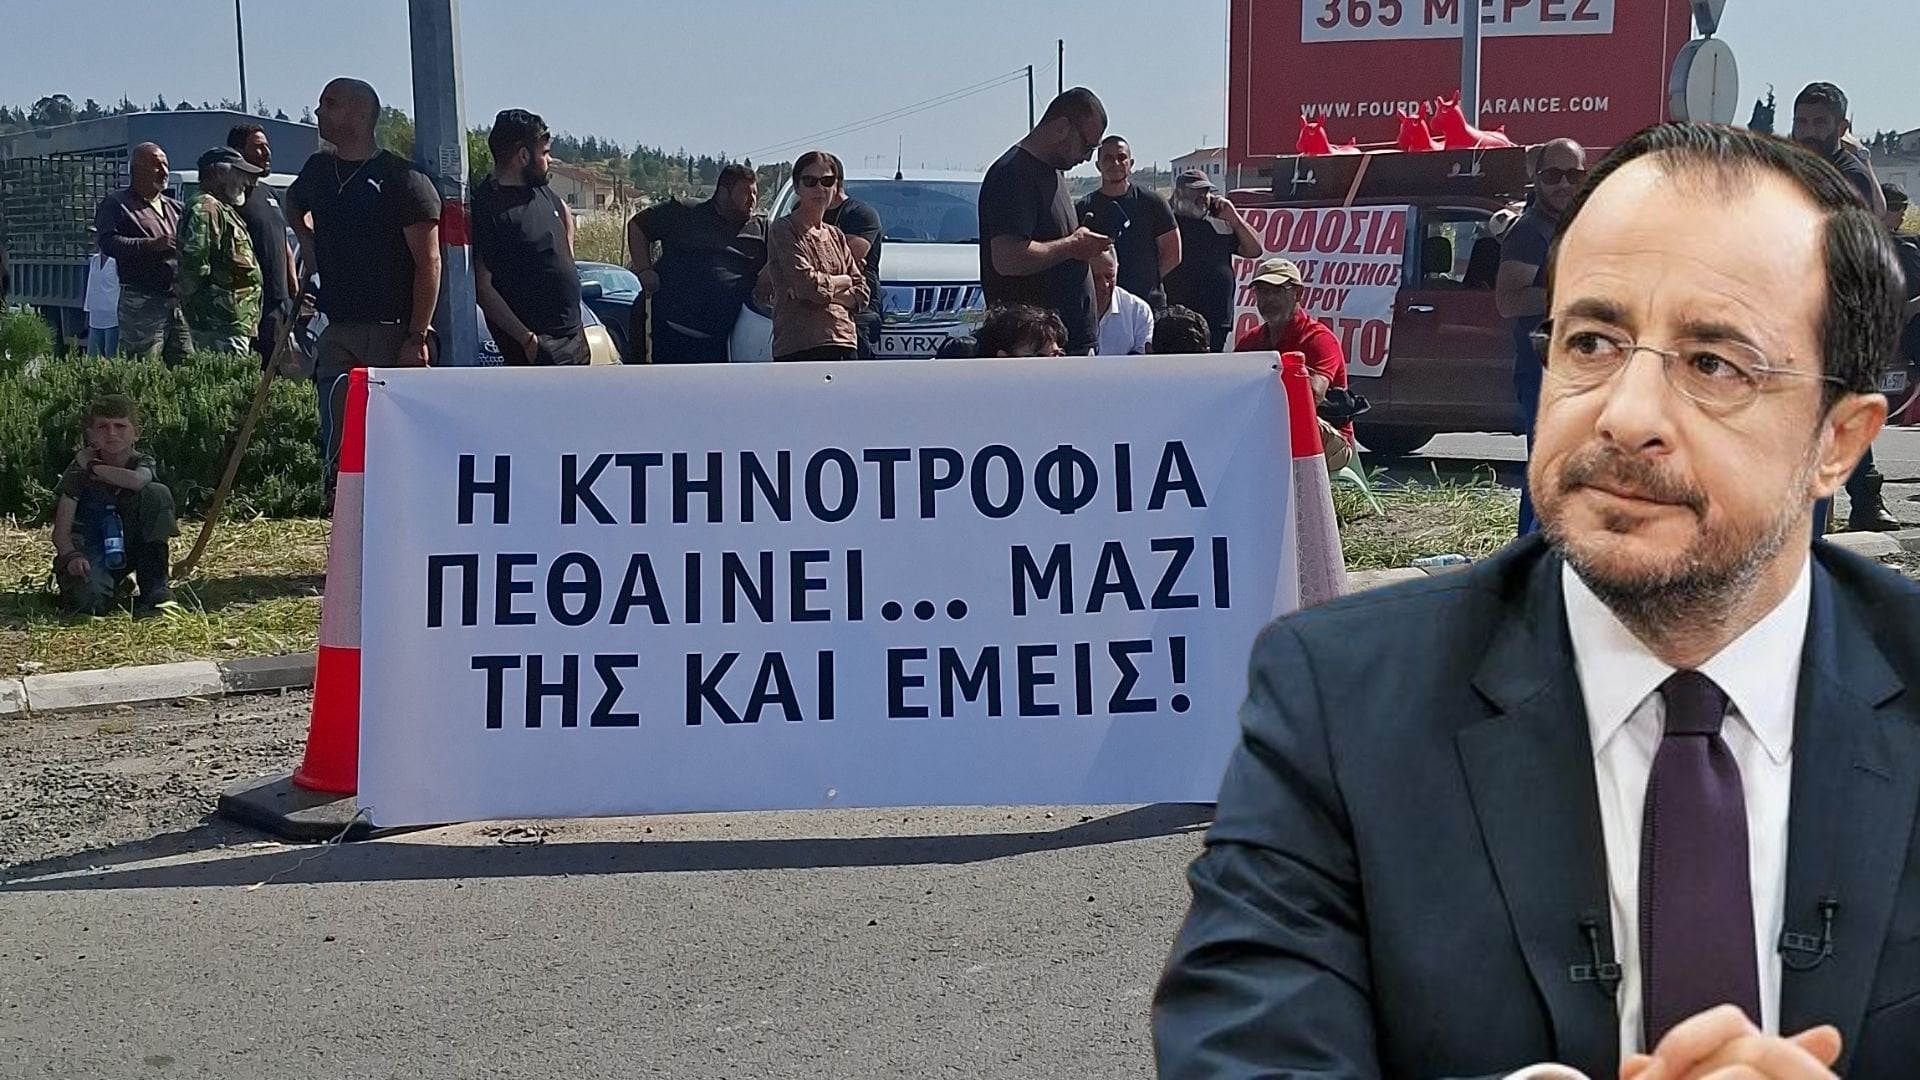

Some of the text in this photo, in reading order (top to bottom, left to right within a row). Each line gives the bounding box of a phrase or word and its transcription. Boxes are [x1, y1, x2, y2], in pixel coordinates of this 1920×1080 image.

[1316, 0, 1402, 28] 365
[1237, 209, 1407, 255] ΡΟΔΟΣΙΑ
[1319, 260, 1401, 287] ΚΟΣΜΟΣ
[900, 336, 938, 352] YRX
[456, 440, 1208, 526] Η ΚΤΗΝΟΤΡΟΦΙΑ
[425, 536, 1232, 629] ΠΕΘΑΙΝΕΙ... ΜΑΖΙ
[471, 635, 1192, 730] ΤΗΣ ΚΑΙ ΕΜΕΙΣ!
